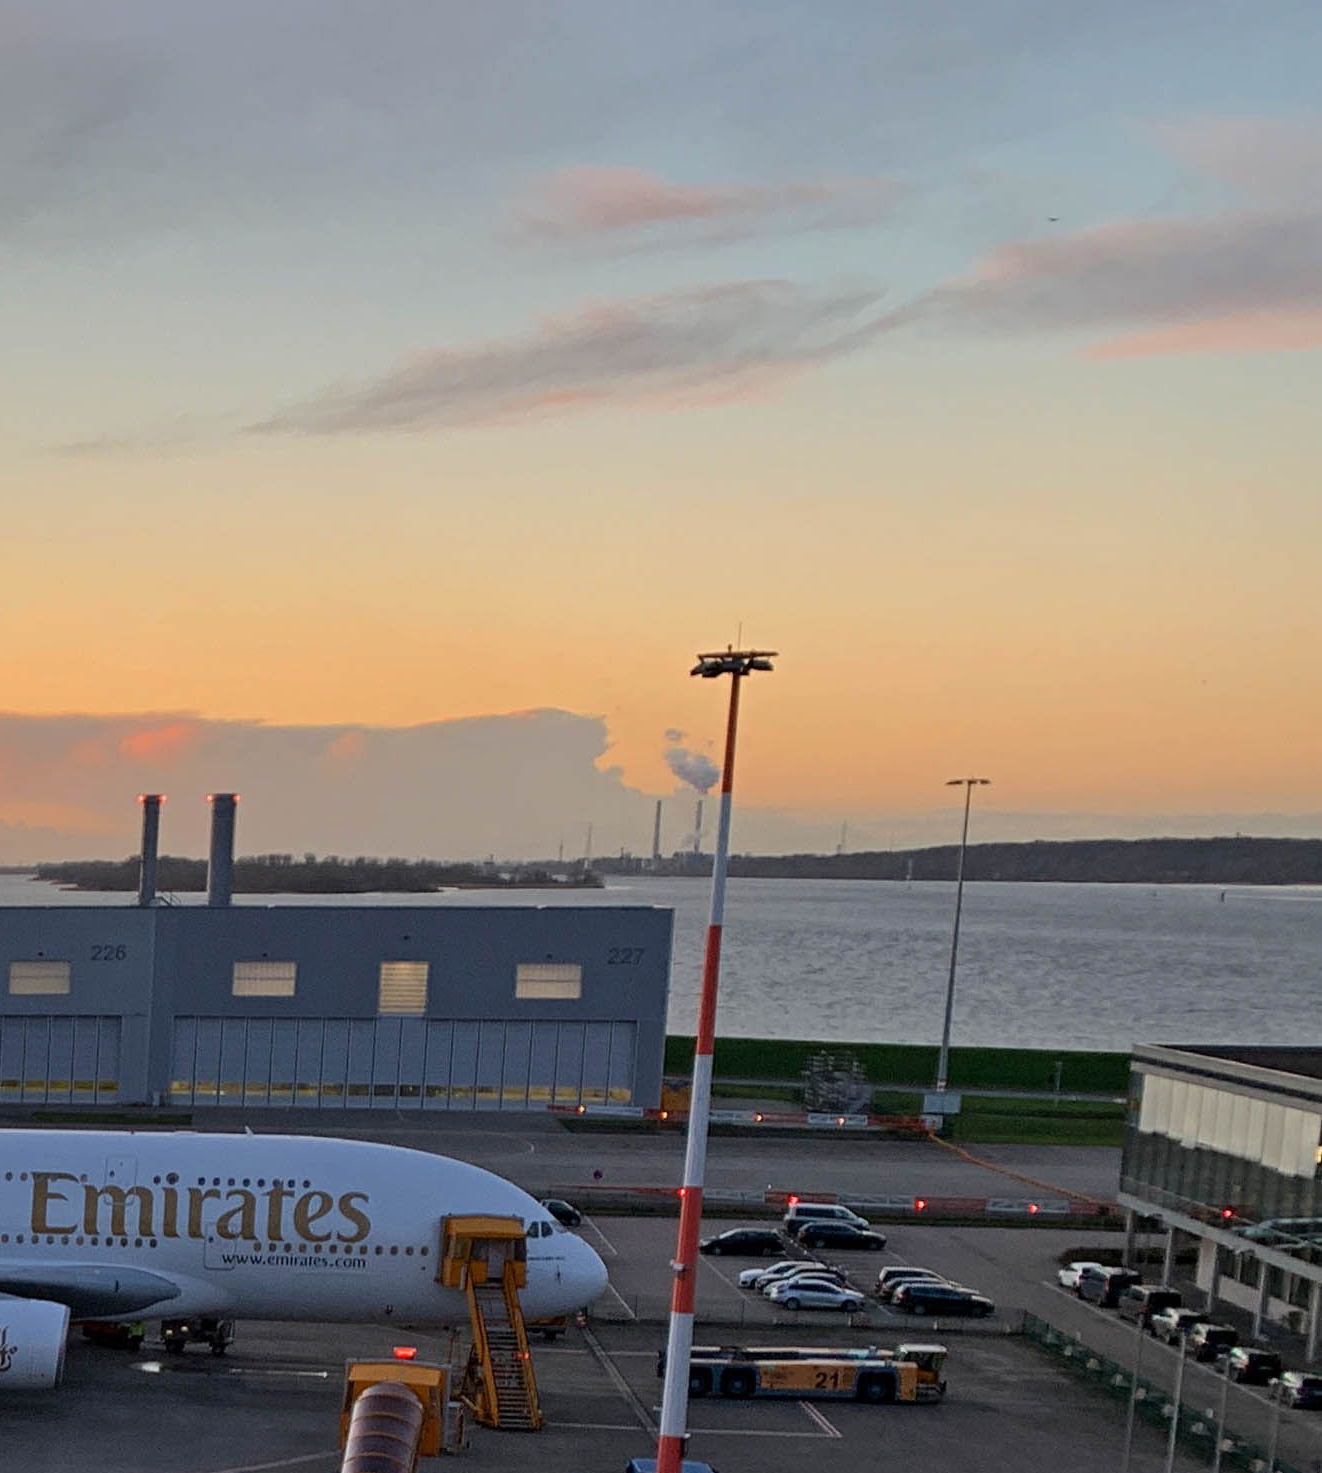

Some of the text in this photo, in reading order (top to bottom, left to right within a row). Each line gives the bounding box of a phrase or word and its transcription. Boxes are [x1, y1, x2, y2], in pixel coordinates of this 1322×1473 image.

[91, 944, 126, 961] 226
[607, 946, 645, 966] 227
[30, 1171, 372, 1244] Emirates
[222, 1251, 368, 1269] www.emirates.com
[814, 1371, 841, 1390] 21
